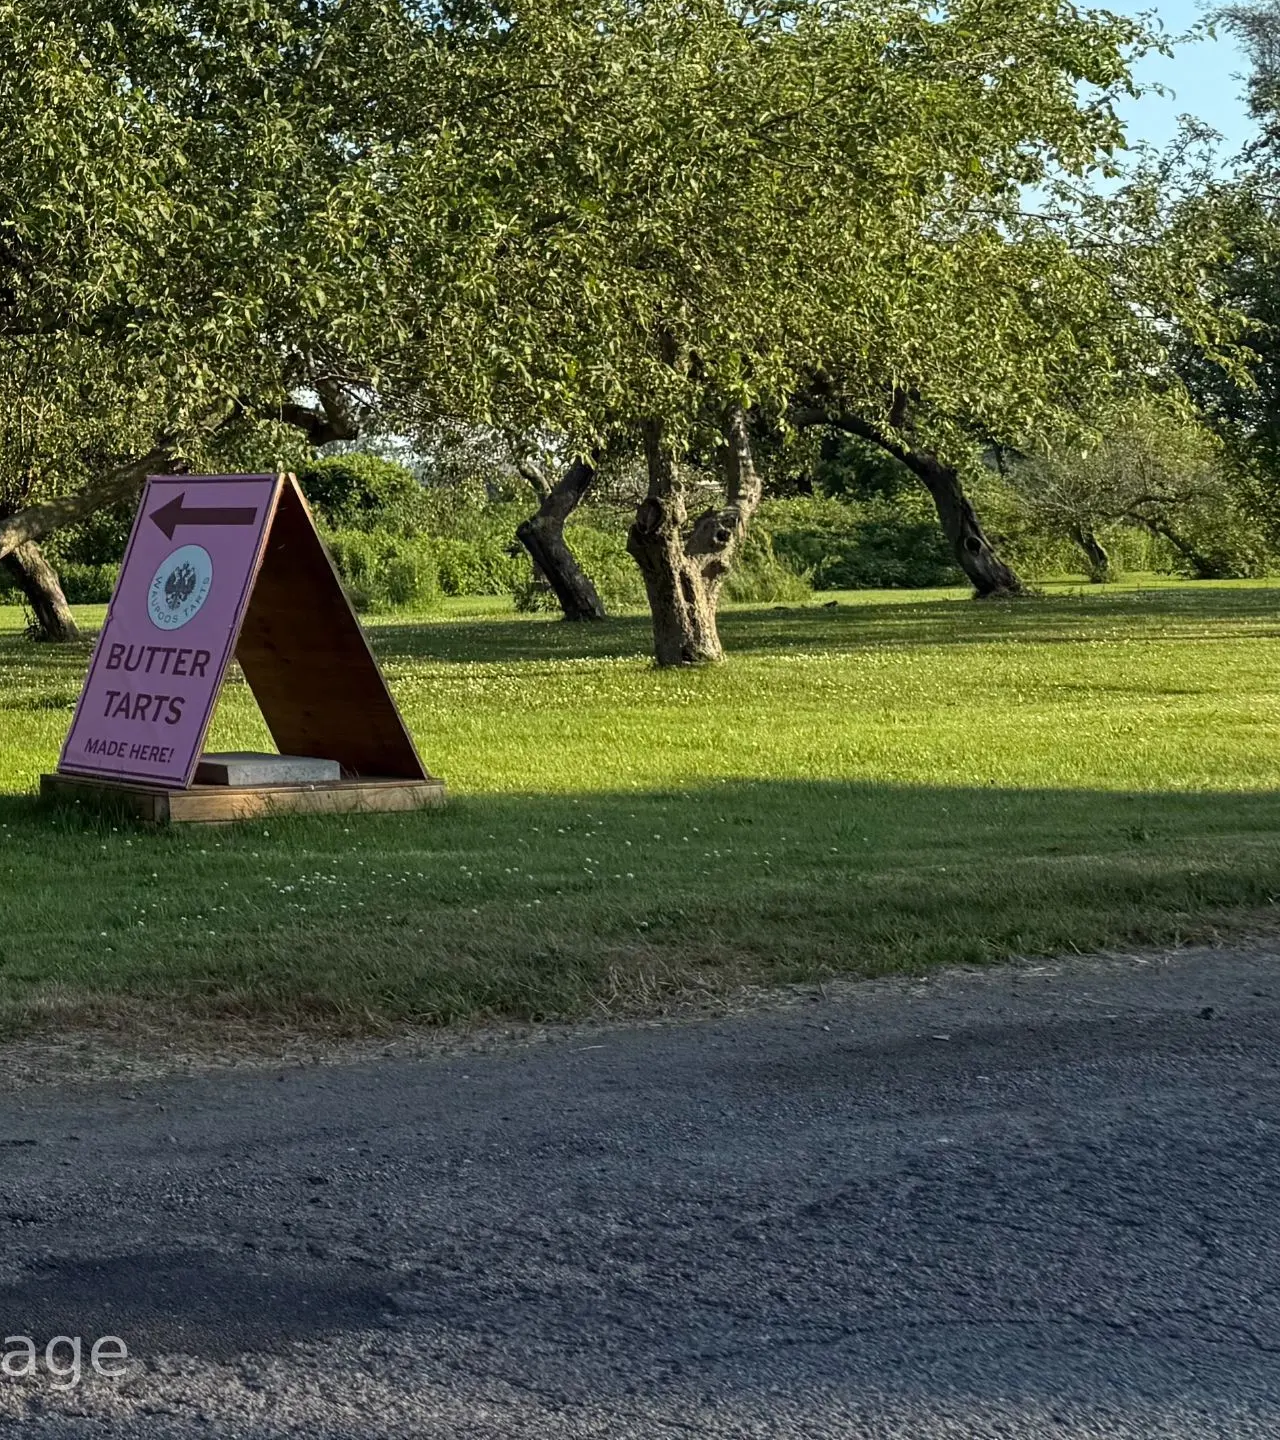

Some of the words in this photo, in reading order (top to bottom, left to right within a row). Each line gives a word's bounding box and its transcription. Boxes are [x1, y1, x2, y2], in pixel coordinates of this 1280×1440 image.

[105, 643, 211, 678] BUTTER
[104, 690, 186, 725] TARTS
[84, 738, 128, 758] MADE
[129, 743, 175, 763] HERE!
